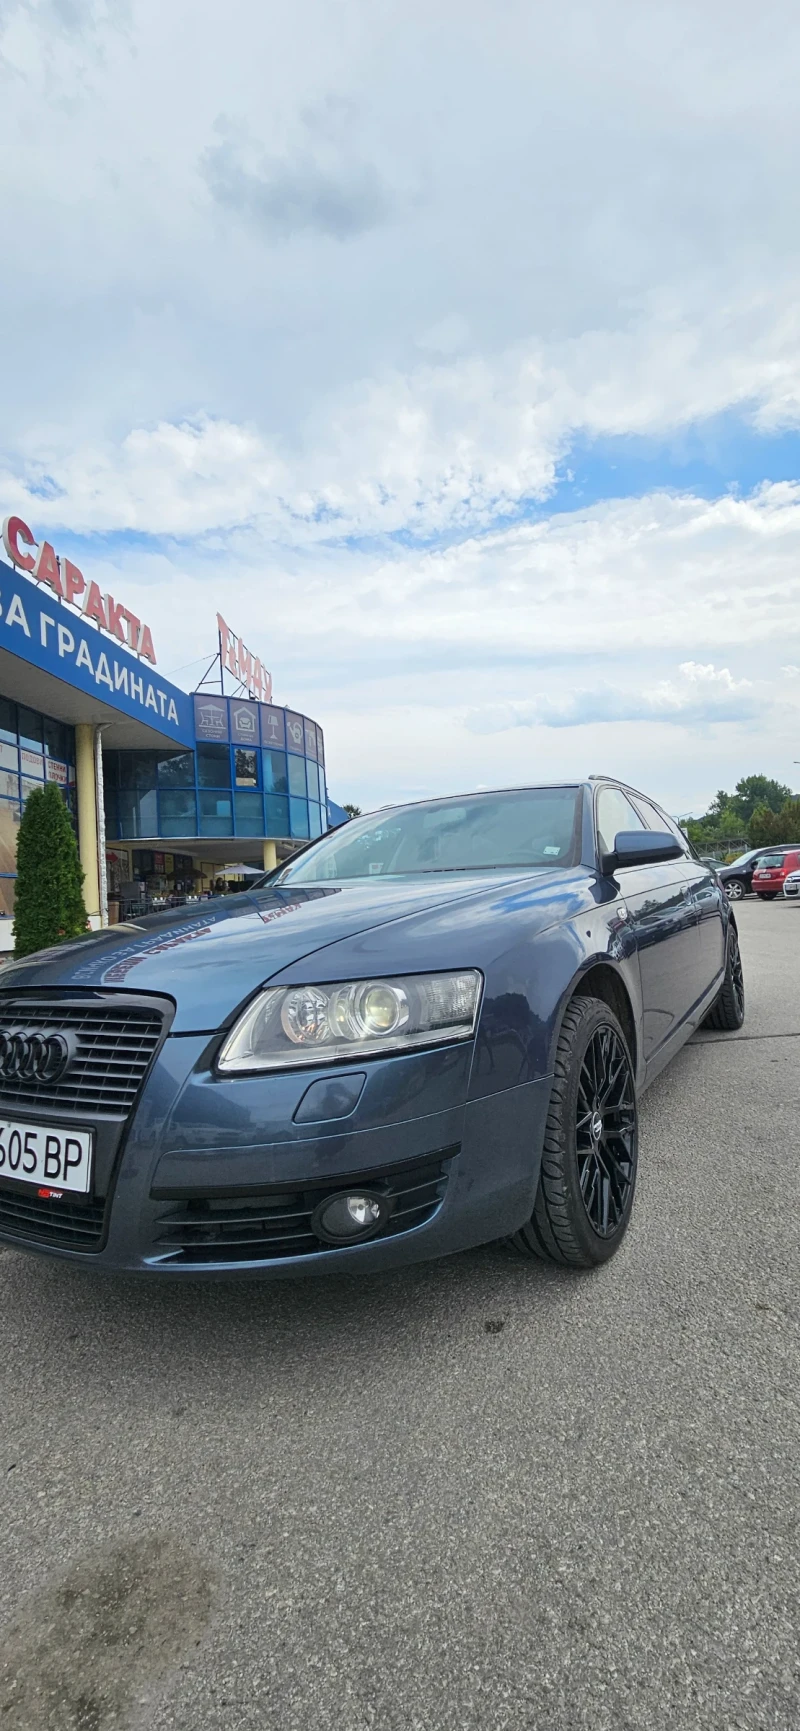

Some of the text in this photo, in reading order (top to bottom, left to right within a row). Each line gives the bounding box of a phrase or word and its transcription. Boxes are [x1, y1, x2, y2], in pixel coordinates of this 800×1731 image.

[3, 516, 156, 665] САРАКТА
[0, 591, 179, 725] А ГРАДИНАТА
[44, 1135, 82, 1181] BP
